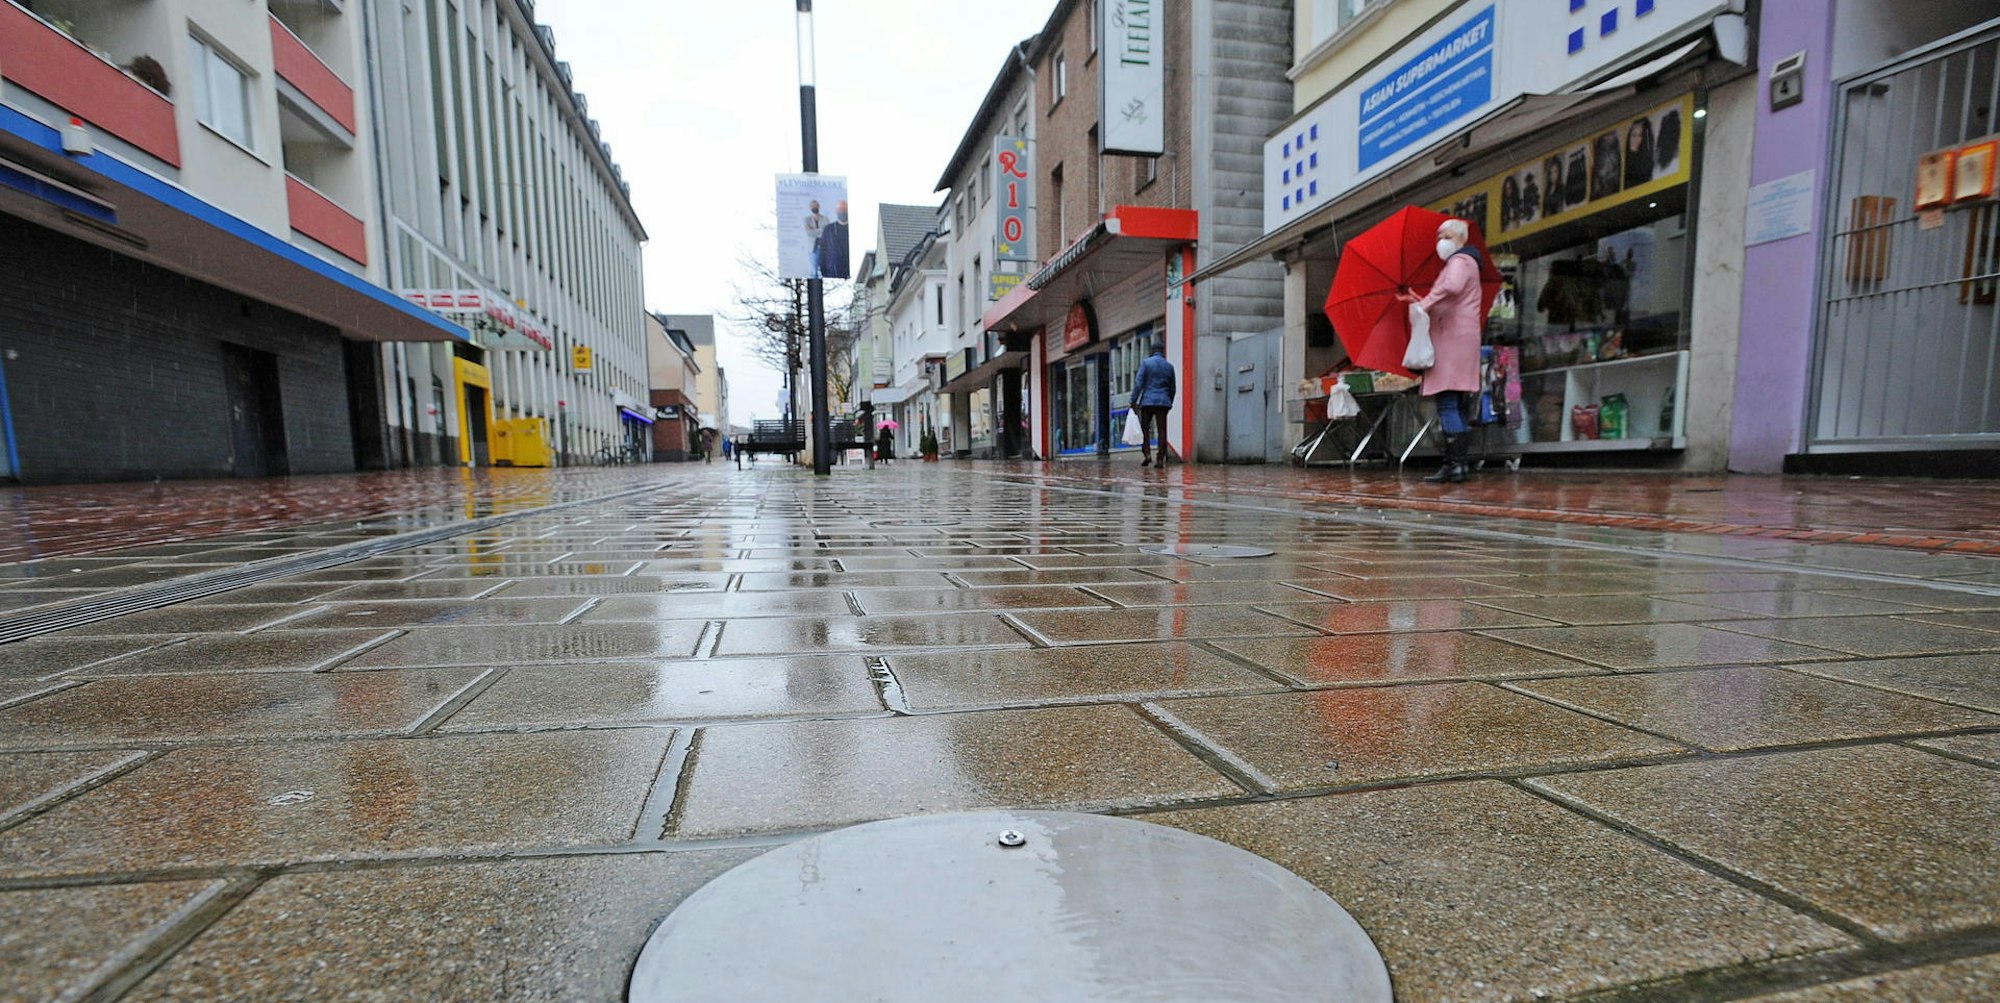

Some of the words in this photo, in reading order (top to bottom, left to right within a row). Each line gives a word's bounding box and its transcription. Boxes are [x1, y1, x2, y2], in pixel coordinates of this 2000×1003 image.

[1362, 81, 1395, 116] ASIAN
[1395, 18, 1489, 93] SUPERMARKET
[998, 150, 1028, 243] RIO
